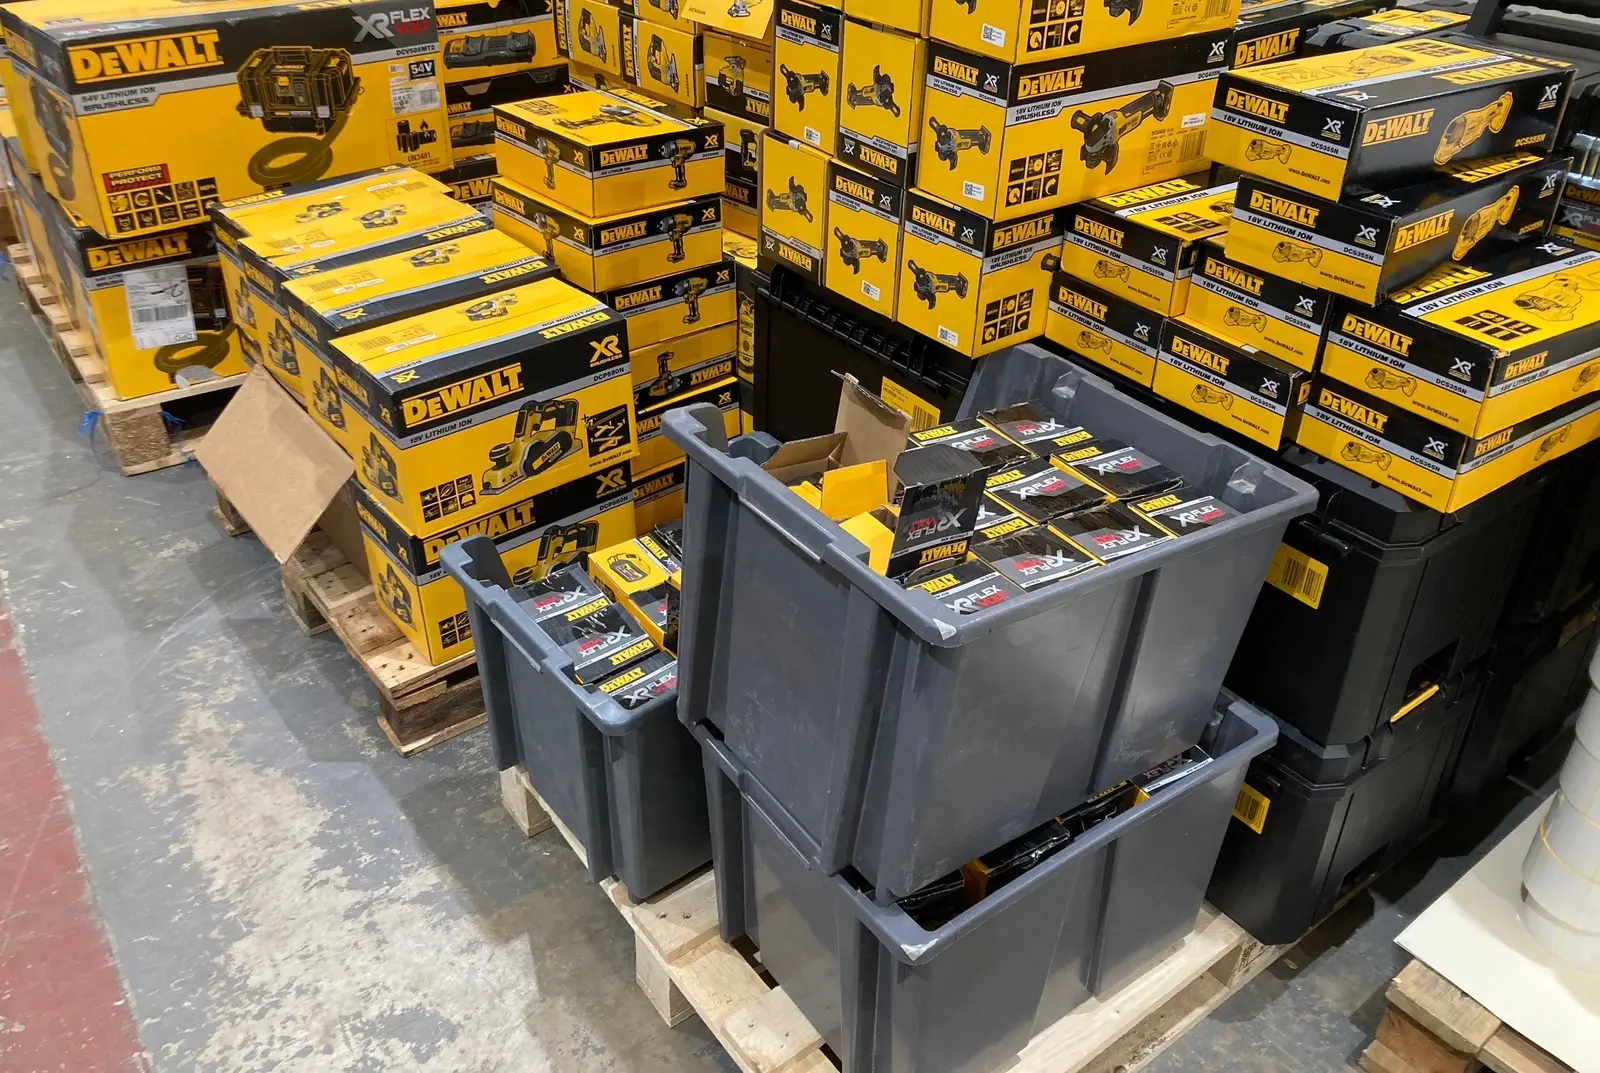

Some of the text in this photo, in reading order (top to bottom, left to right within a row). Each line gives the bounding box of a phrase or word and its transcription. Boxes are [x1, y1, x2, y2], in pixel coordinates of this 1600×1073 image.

[352, 7, 430, 42] XR FLEX
[781, 11, 816, 34] DEWALT
[69, 32, 222, 82] DEWALT
[1209, 42, 1226, 56] XR
[1235, 29, 1300, 67] DEWALT
[411, 62, 433, 76] 54V
[934, 57, 979, 85] DEWALT
[101, 86, 156, 100] LITHIUM ION
[1018, 68, 1085, 98] DEWALT
[1541, 83, 1559, 101] XR
[84, 97, 149, 111] BRUSHLESS
[1016, 107, 1027, 115] 18V
[1027, 102, 1050, 113] LITHIUM
[1226, 89, 1290, 123] DEWALT
[1015, 109, 1055, 122] BRUSHLESS
[1223, 114, 1283, 138] 18V LITHIUM ION
[1323, 117, 1341, 134] XR
[1362, 109, 1435, 146] DEWALT
[600, 145, 648, 166] DEWALT
[1310, 141, 1339, 155] DCS355N
[109, 164, 162, 179] PERFORM
[111, 173, 163, 187] PROTECT
[1541, 173, 1557, 191] XR
[835, 177, 874, 203] DEWALT
[1128, 191, 1209, 214] 18V LITHIUM ION
[1250, 191, 1319, 227] DEWALT
[912, 208, 956, 236] DEWALT
[993, 215, 1054, 249] DEWALT
[1074, 216, 1125, 247] DEWALT
[1248, 215, 1313, 241] 18V LITHIUM ION
[1394, 210, 1455, 252] DEWALT
[600, 221, 647, 245] DEWALT
[1357, 225, 1376, 241] XR
[88, 233, 190, 270] DEWALT
[1002, 250, 1022, 260] LITHIUM
[1023, 246, 1033, 254] ION
[1073, 236, 1121, 259] 18V LITHIUM ION
[1152, 245, 1166, 260] XR
[1343, 247, 1374, 261] DCS355N
[990, 255, 1027, 270] BRUSHLESS
[1204, 257, 1264, 296] DEWALT
[615, 286, 662, 310] DEWALT
[1058, 287, 1107, 321] DEWALT
[1202, 280, 1259, 308] 18V LITHIUM ION
[1296, 295, 1314, 311] XR
[1418, 281, 1504, 313] 18V LITHIUM ION
[1057, 306, 1104, 333] 18V LITHIUM ION
[1134, 322, 1150, 337] XR
[1284, 315, 1311, 330] DCS355N
[1342, 315, 1413, 356] DEWALT
[590, 334, 622, 361] XR
[1171, 336, 1229, 376] DEWALT
[1339, 337, 1405, 369] 18V LITHIUM ION
[593, 367, 624, 382] DCP580N
[1170, 358, 1225, 387] 18V LITHIUM ION
[1451, 357, 1471, 375] XR
[1504, 352, 1548, 380] DEWALT
[1260, 377, 1280, 394] XR
[1435, 378, 1467, 394] DCS355N
[1512, 374, 1537, 388] LITHIUM
[402, 366, 523, 424] DEWALT
[1250, 395, 1276, 411] DCS355N
[1319, 390, 1388, 432] DEWALT
[410, 418, 473, 444] 18V LITHIUM ION
[1316, 411, 1380, 445] 18V LITHIUM ION
[963, 434, 989, 446] FLEX
[1425, 436, 1445, 454] XR
[1474, 427, 1514, 457] DEWALT
[1110, 455, 1136, 466] FLEX
[1410, 455, 1440, 472] DCS355N
[1482, 448, 1504, 464] LITHIUM
[596, 467, 626, 491] XR
[1034, 476, 1063, 492] FLEX
[599, 495, 629, 510] DCP580N
[1193, 504, 1219, 517] FLEX
[906, 508, 967, 541] XR FLEX
[919, 541, 967, 564] DEWALT
[1098, 537, 1128, 550] FLEX
[1019, 562, 1050, 576] FLEX
[966, 585, 1002, 602] FLEX
[536, 600, 565, 614] FLEX
[578, 641, 608, 658] FLEX
[647, 672, 676, 691] FLEX
